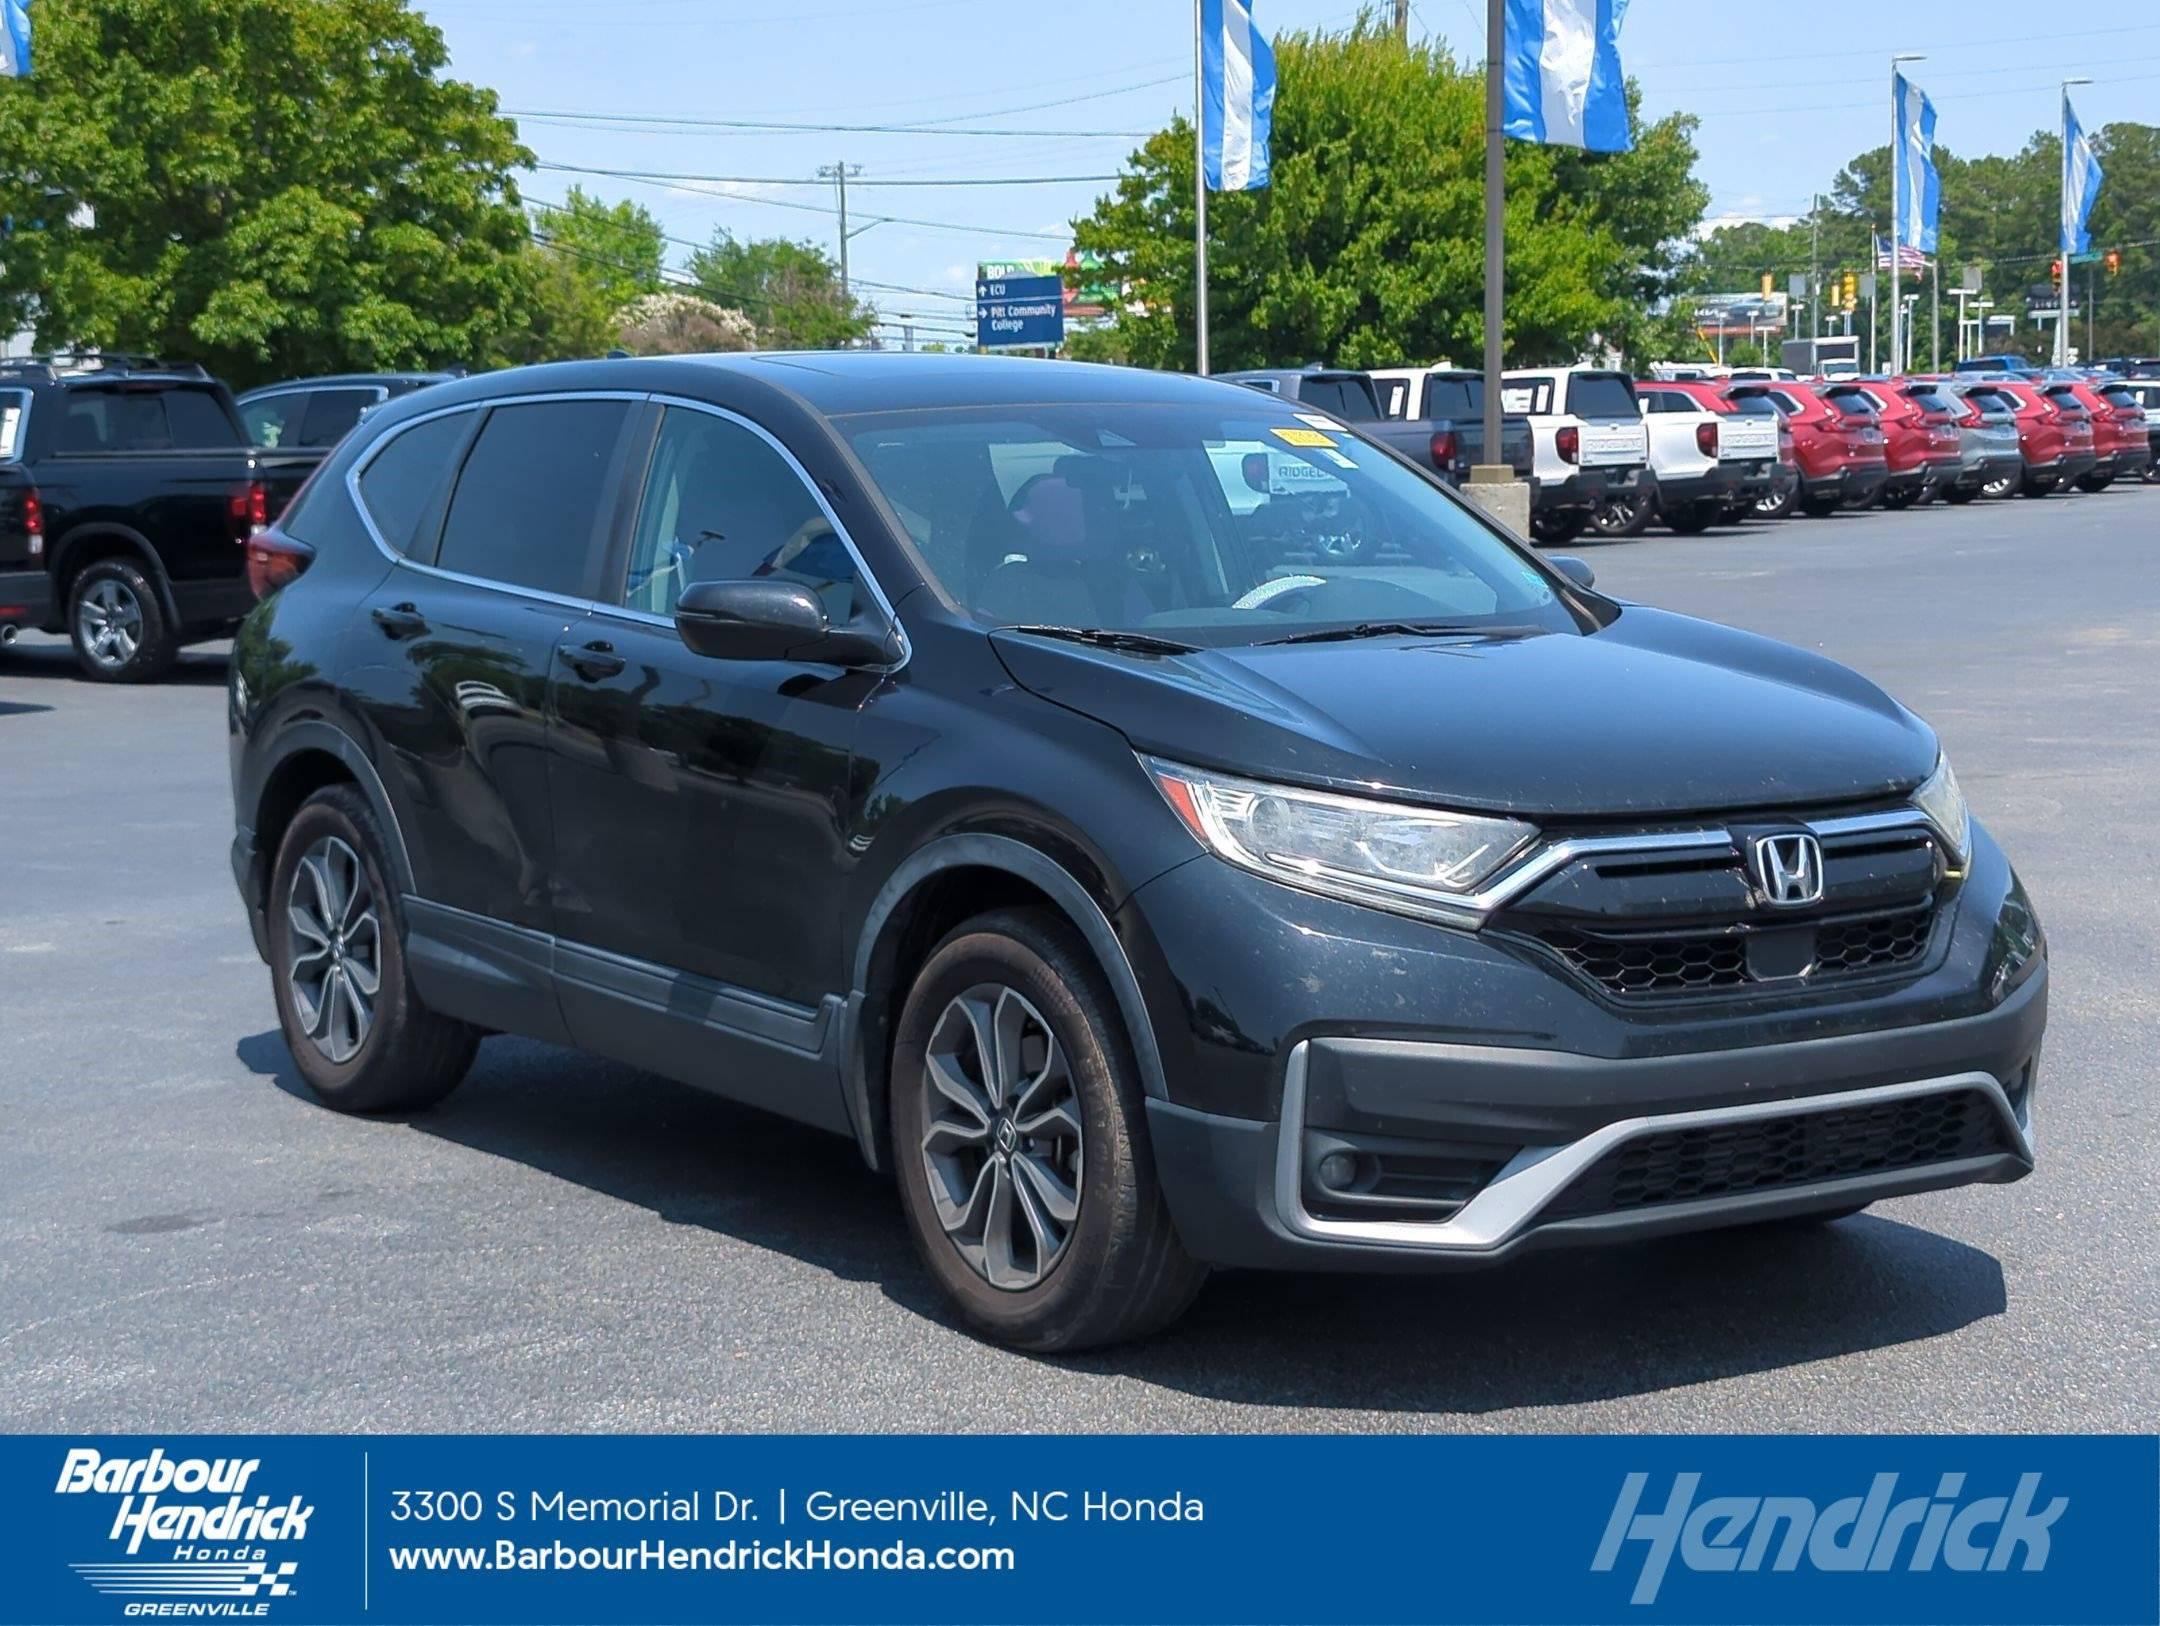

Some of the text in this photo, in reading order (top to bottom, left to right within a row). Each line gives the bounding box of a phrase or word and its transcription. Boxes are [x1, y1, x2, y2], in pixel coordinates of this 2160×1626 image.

[989, 283, 1006, 296] ECU
[1007, 304, 1056, 318] Community
[991, 319, 1024, 333] College
[1279, 466, 1327, 478] RIDGEL
